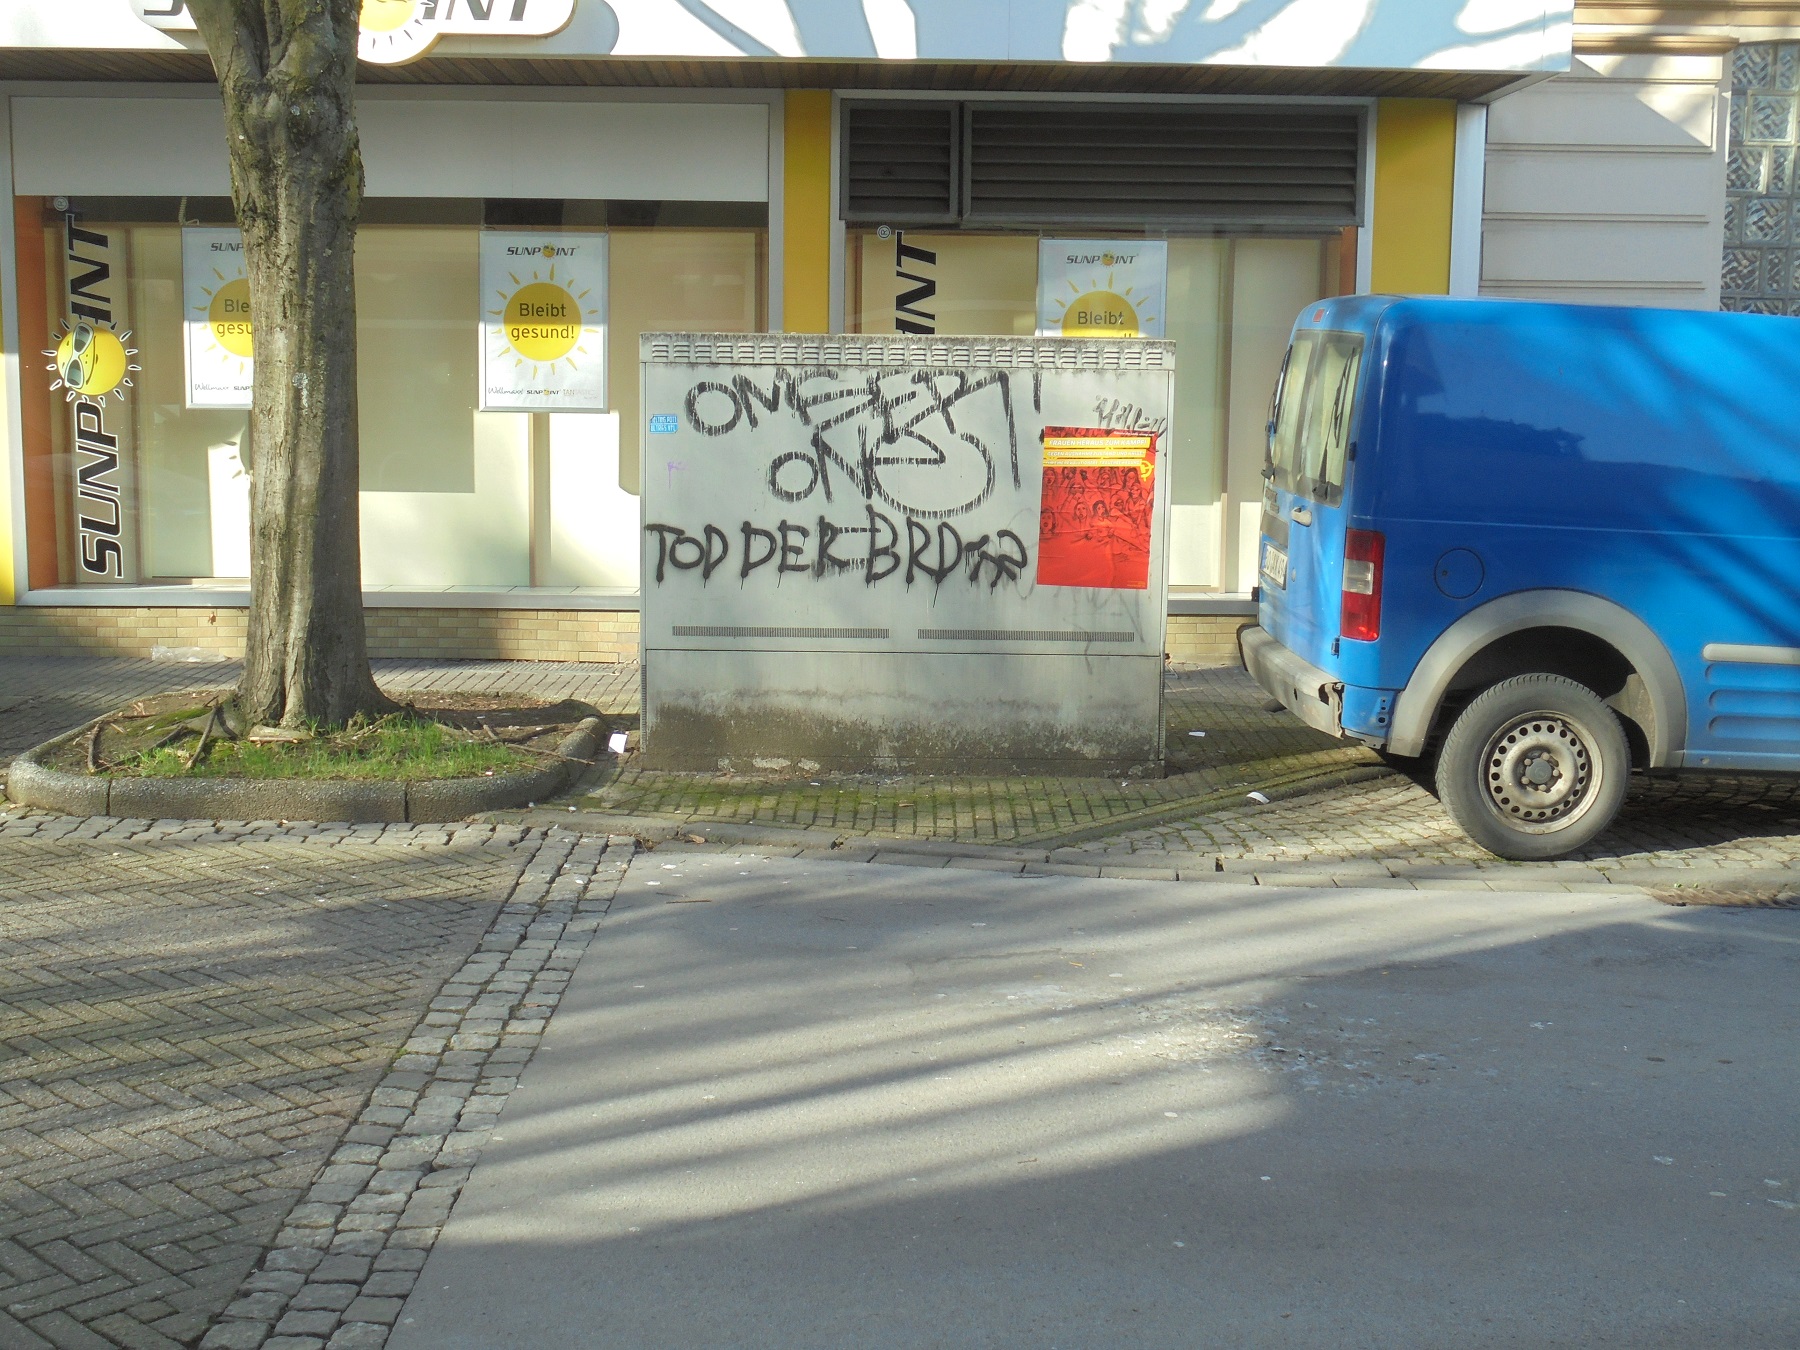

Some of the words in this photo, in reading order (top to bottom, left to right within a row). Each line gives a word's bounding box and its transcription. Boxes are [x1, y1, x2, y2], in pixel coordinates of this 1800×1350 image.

[210, 242, 244, 252] SUNP
[224, 299, 250, 313] Ble
[519, 302, 567, 317] Bleibt
[1077, 311, 1125, 325] Bleibt
[216, 323, 254, 337] gesu
[511, 326, 575, 342] gesund!
[1105, 439, 1120, 447] ZUM
[645, 521, 729, 587] TOD
[741, 516, 850, 586] DER
[865, 503, 963, 592] BRD
